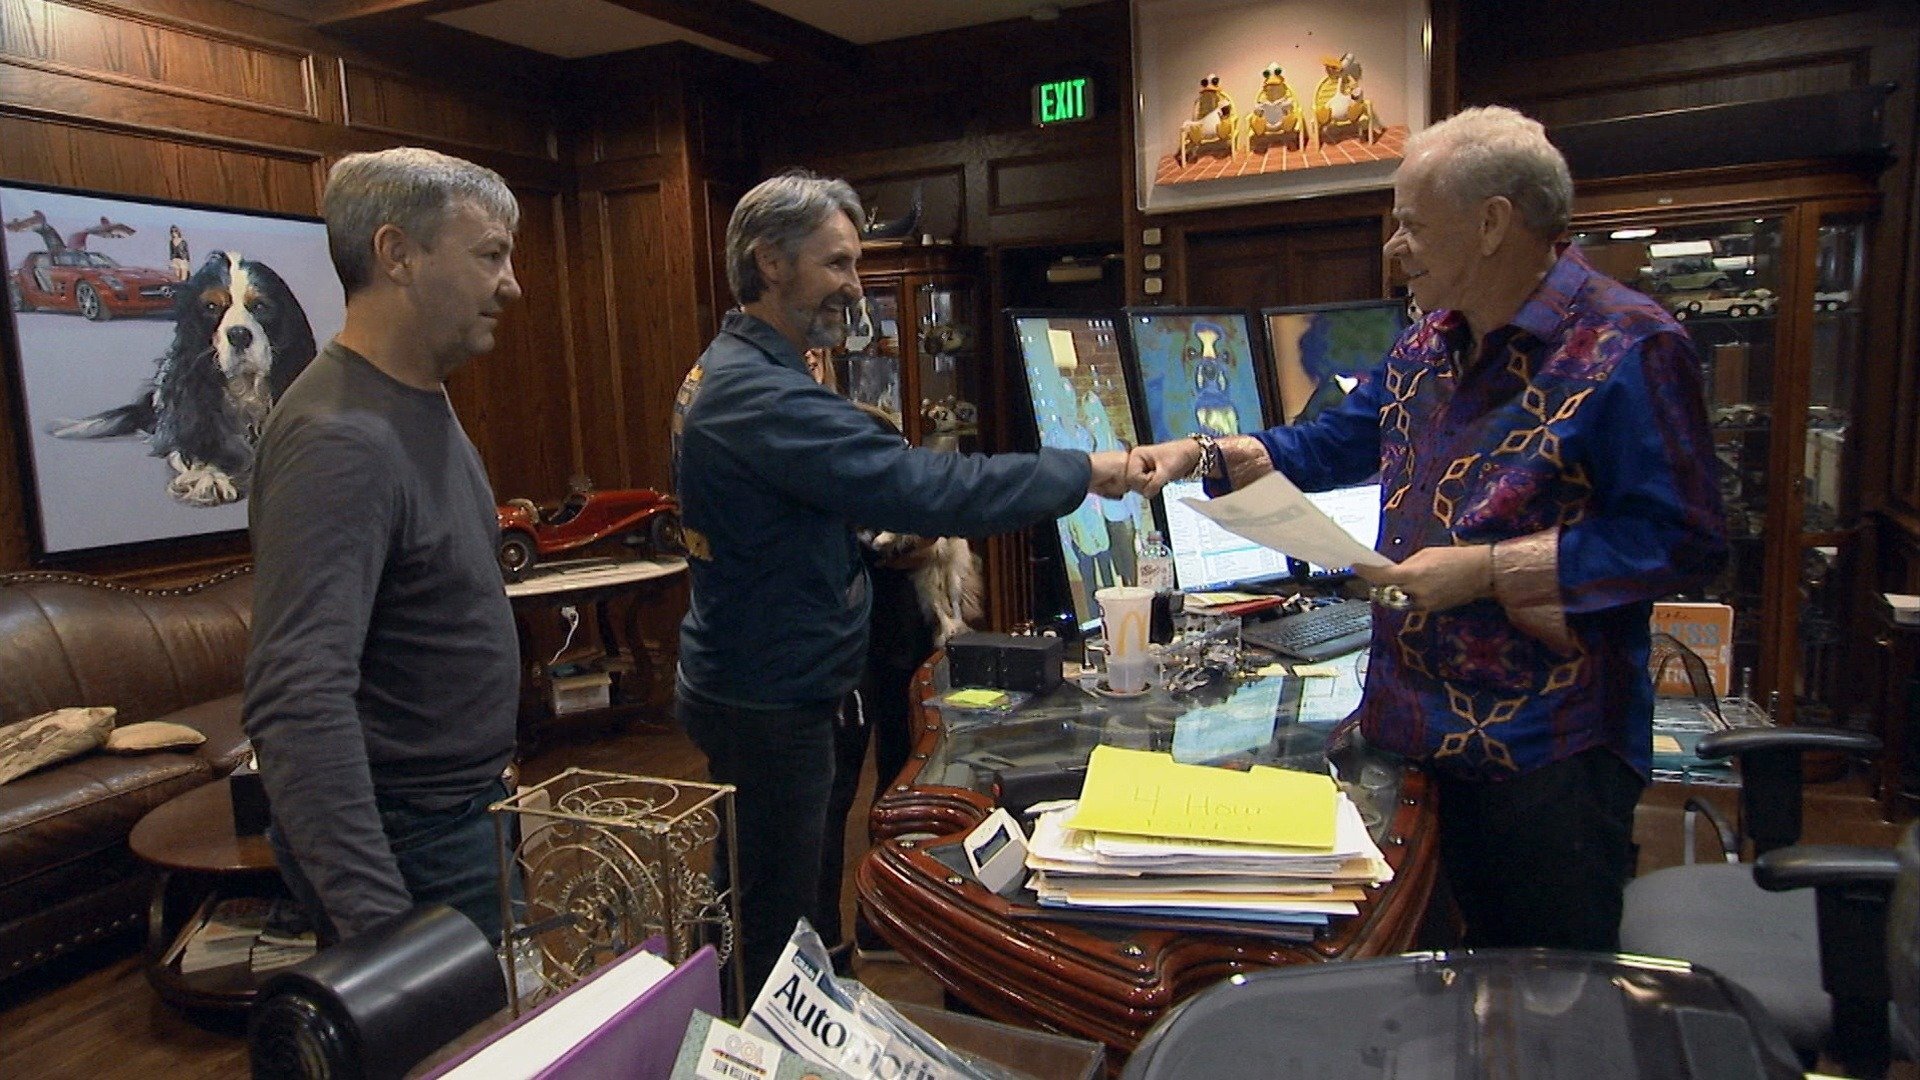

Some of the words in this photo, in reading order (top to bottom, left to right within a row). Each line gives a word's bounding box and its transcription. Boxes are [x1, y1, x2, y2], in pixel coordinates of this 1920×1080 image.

[1041, 79, 1085, 122] EXIT
[1134, 784, 1160, 815] 4
[773, 974, 937, 1080] Autooti
